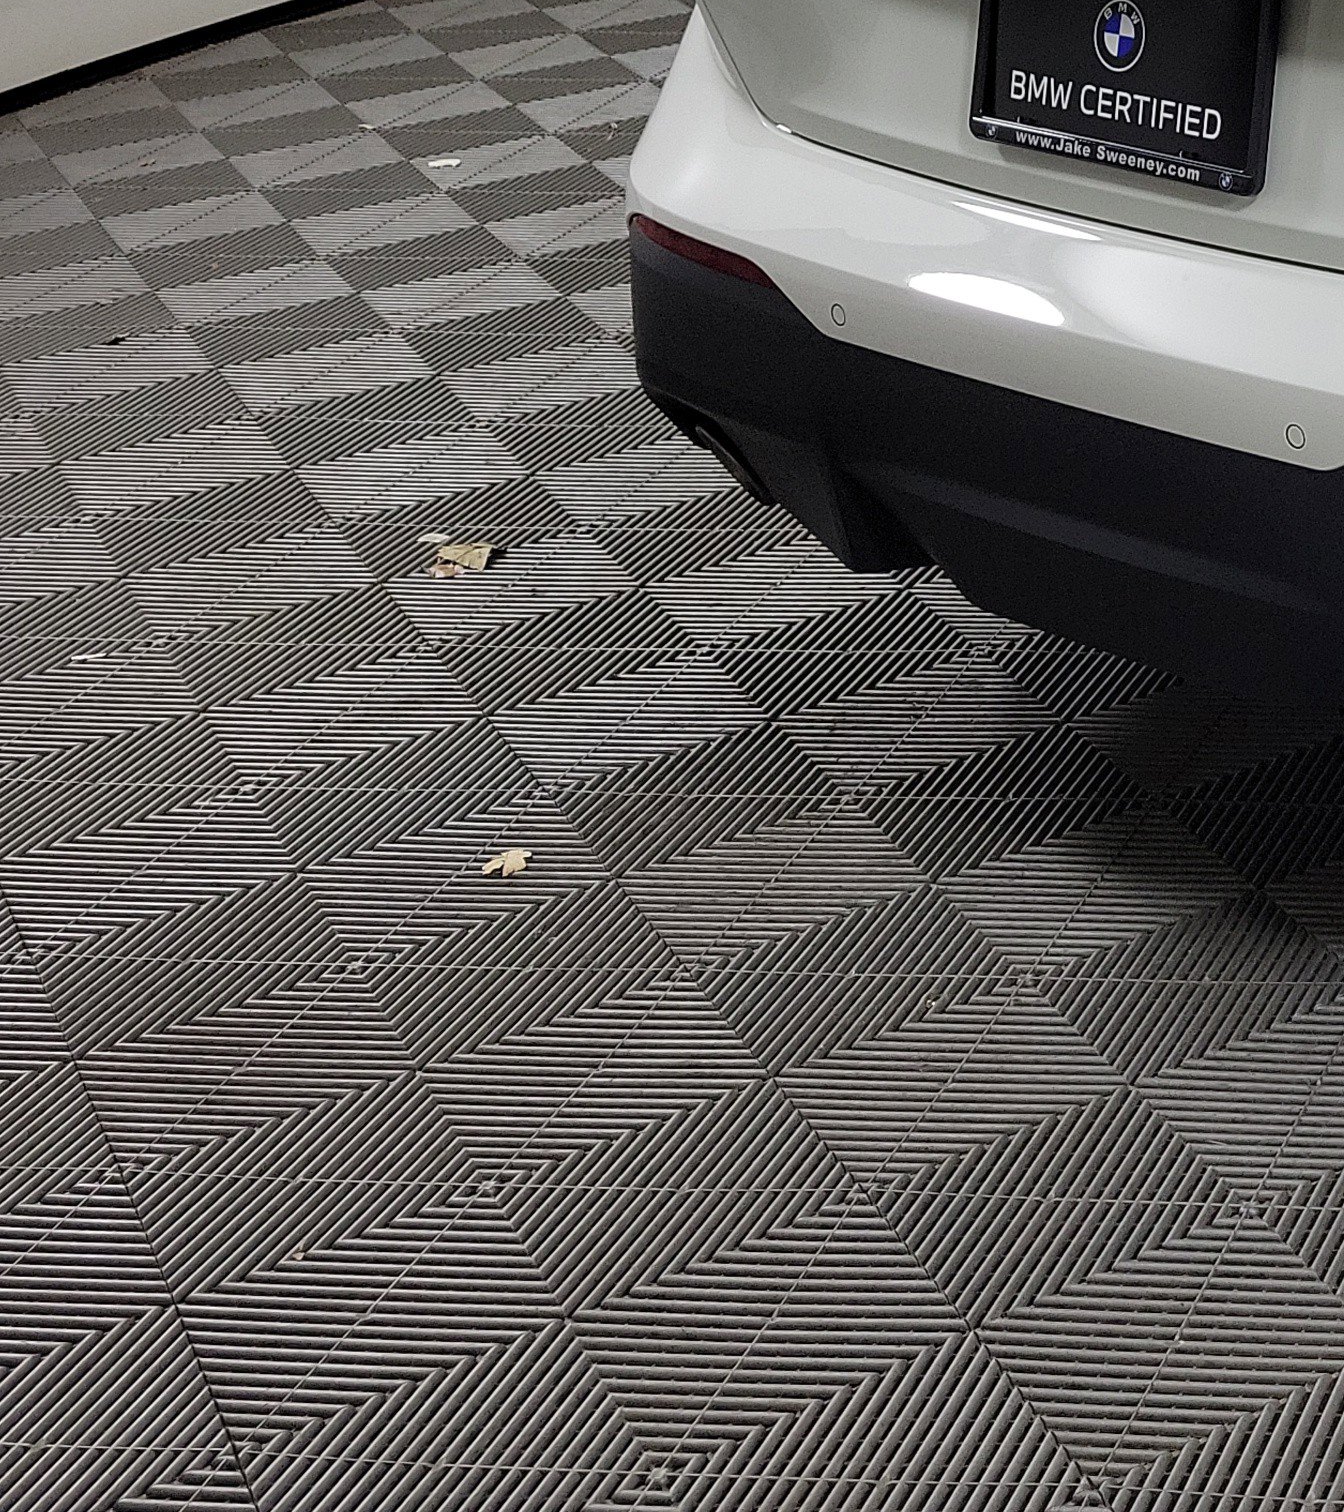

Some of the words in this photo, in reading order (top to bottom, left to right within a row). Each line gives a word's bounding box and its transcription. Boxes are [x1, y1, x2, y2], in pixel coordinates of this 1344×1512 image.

[1010, 69, 1073, 111] BMW
[1079, 84, 1222, 140] CERTIFIED
[1015, 130, 1091, 158] www.Jake
[1096, 145, 1201, 182] Sweeney.com
